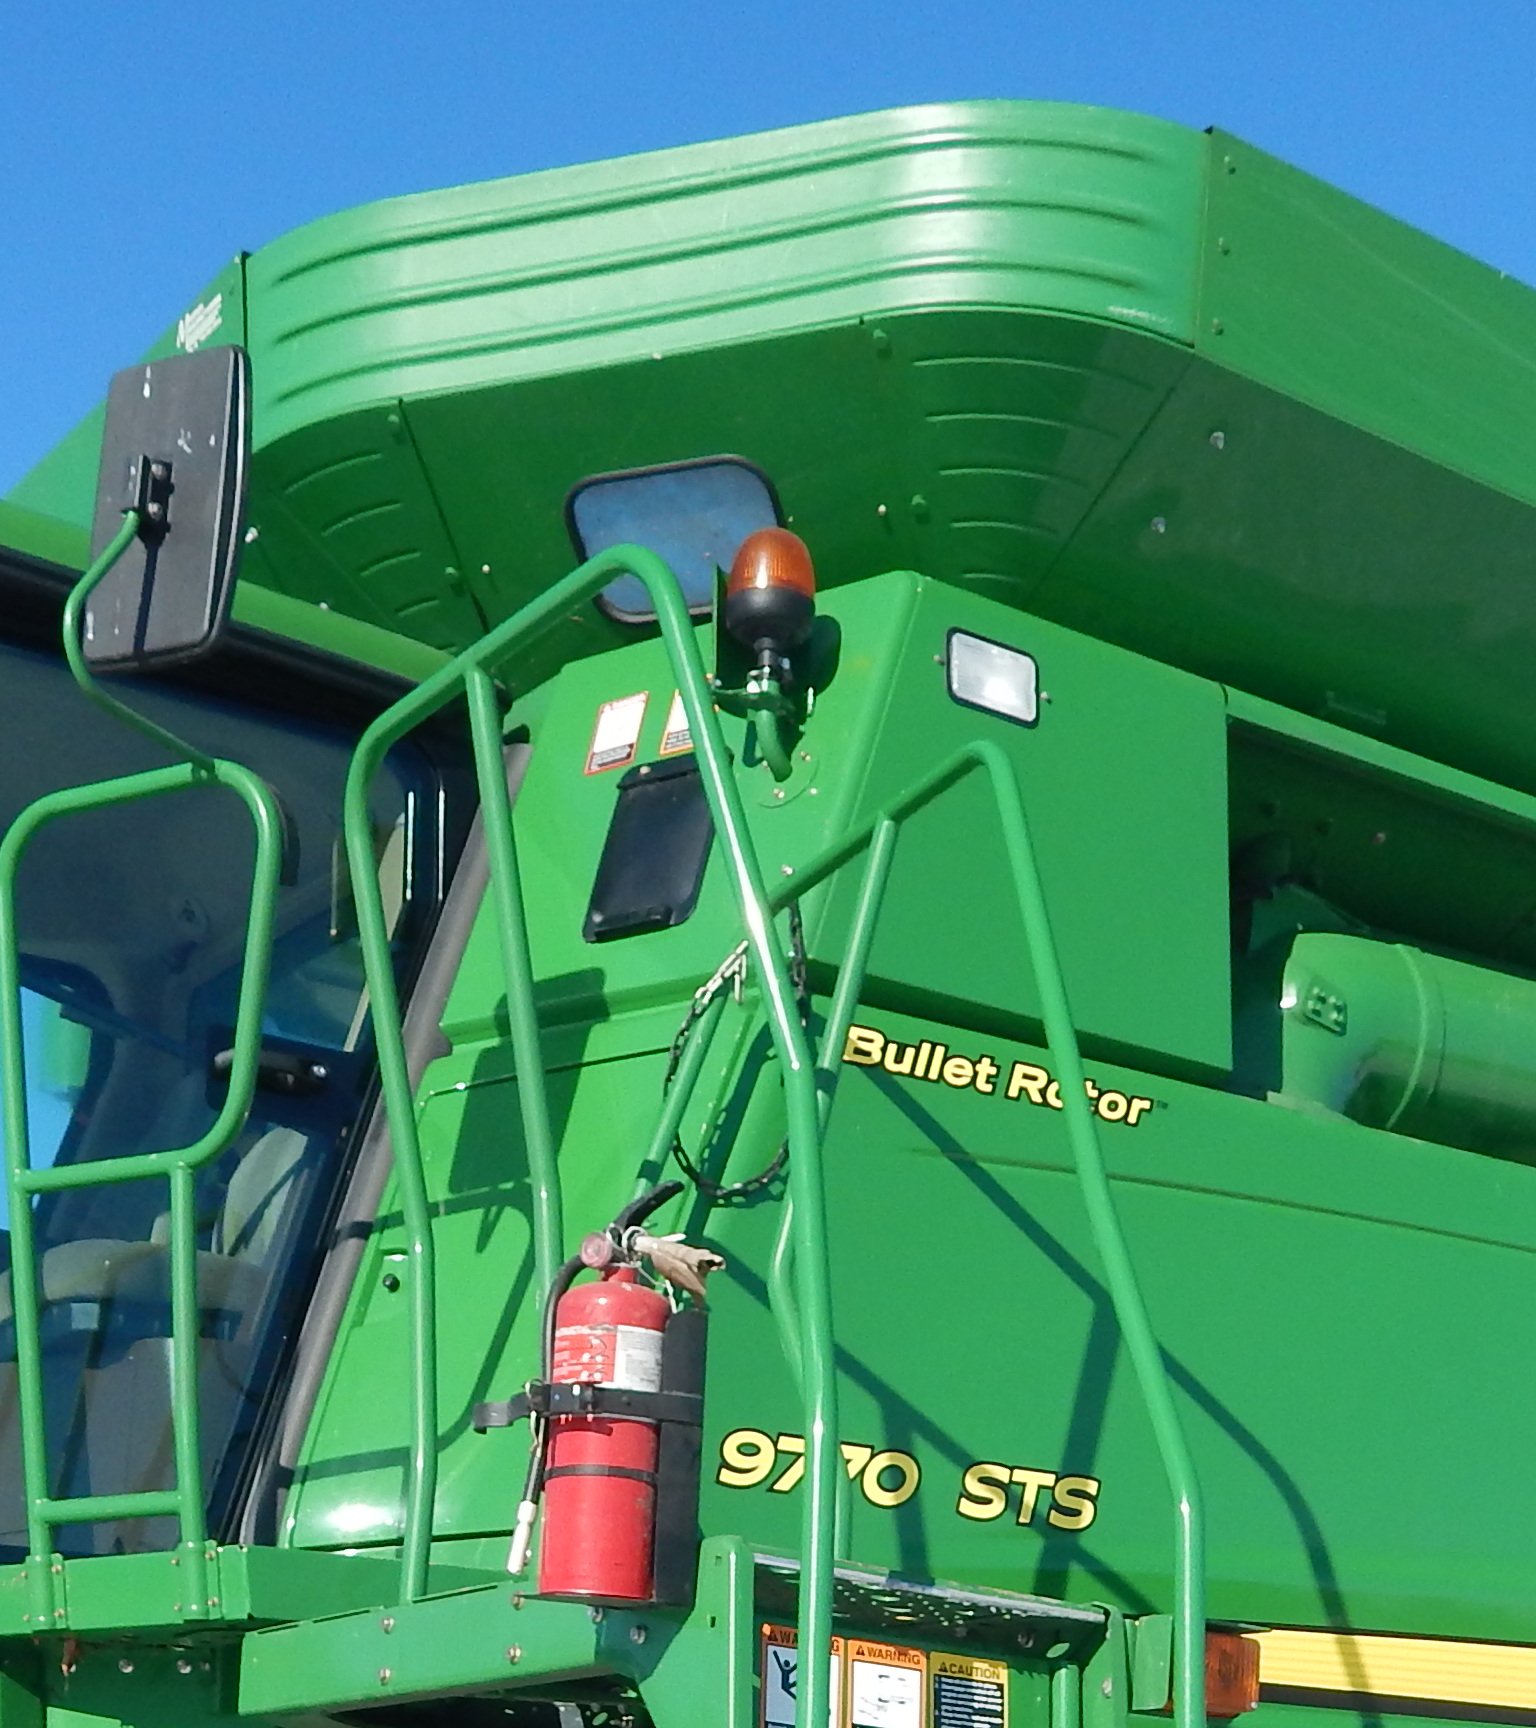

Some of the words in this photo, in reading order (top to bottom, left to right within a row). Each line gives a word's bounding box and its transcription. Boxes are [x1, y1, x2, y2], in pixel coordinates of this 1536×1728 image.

[841, 1023, 1001, 1096] Bullet
[956, 1461, 1101, 1532] STS
[867, 1647, 921, 1665] WARNING
[949, 1663, 1000, 1680] CAUTION
